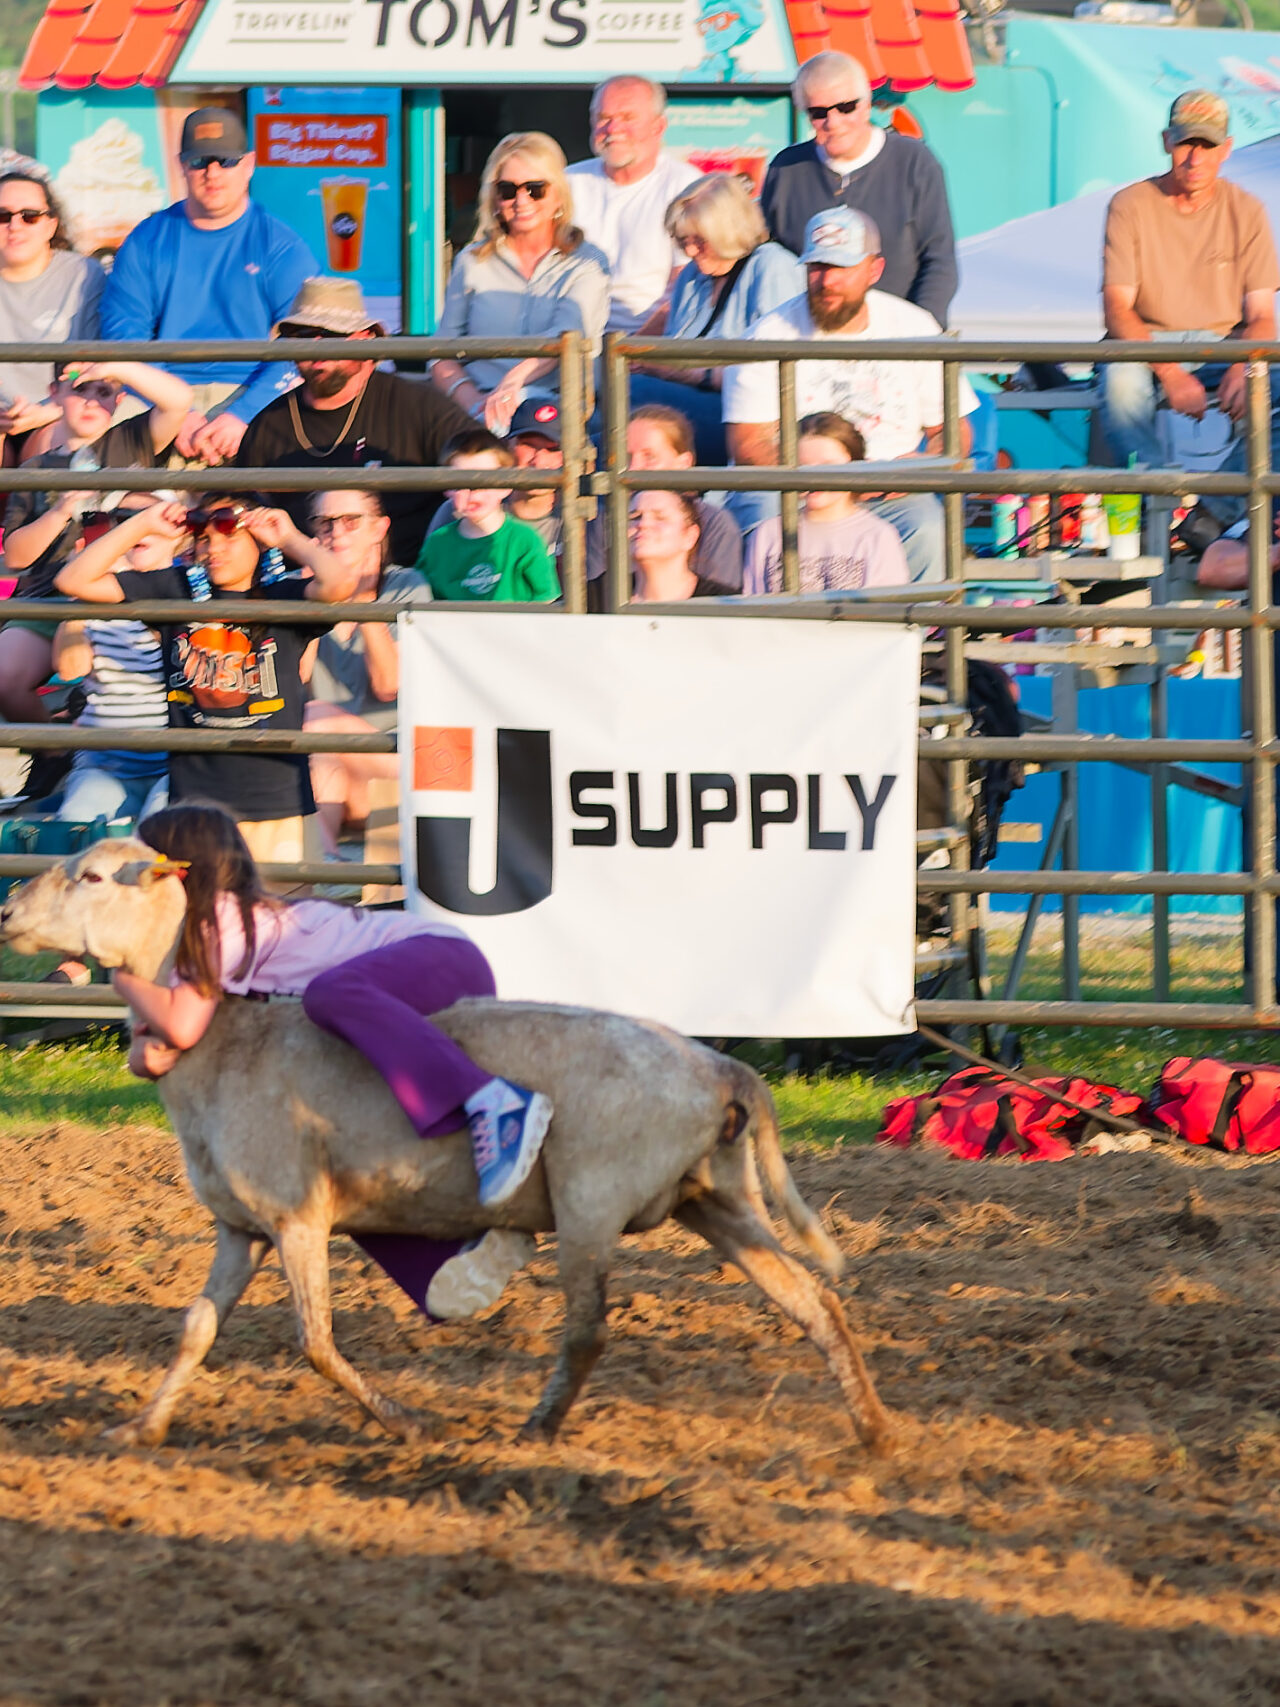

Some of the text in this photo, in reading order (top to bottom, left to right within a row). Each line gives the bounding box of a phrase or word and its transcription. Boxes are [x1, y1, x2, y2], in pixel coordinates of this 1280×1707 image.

[367, 0, 588, 47] TOM'S
[596, 12, 684, 31] COFFEE
[570, 770, 897, 851] SUPPLY
